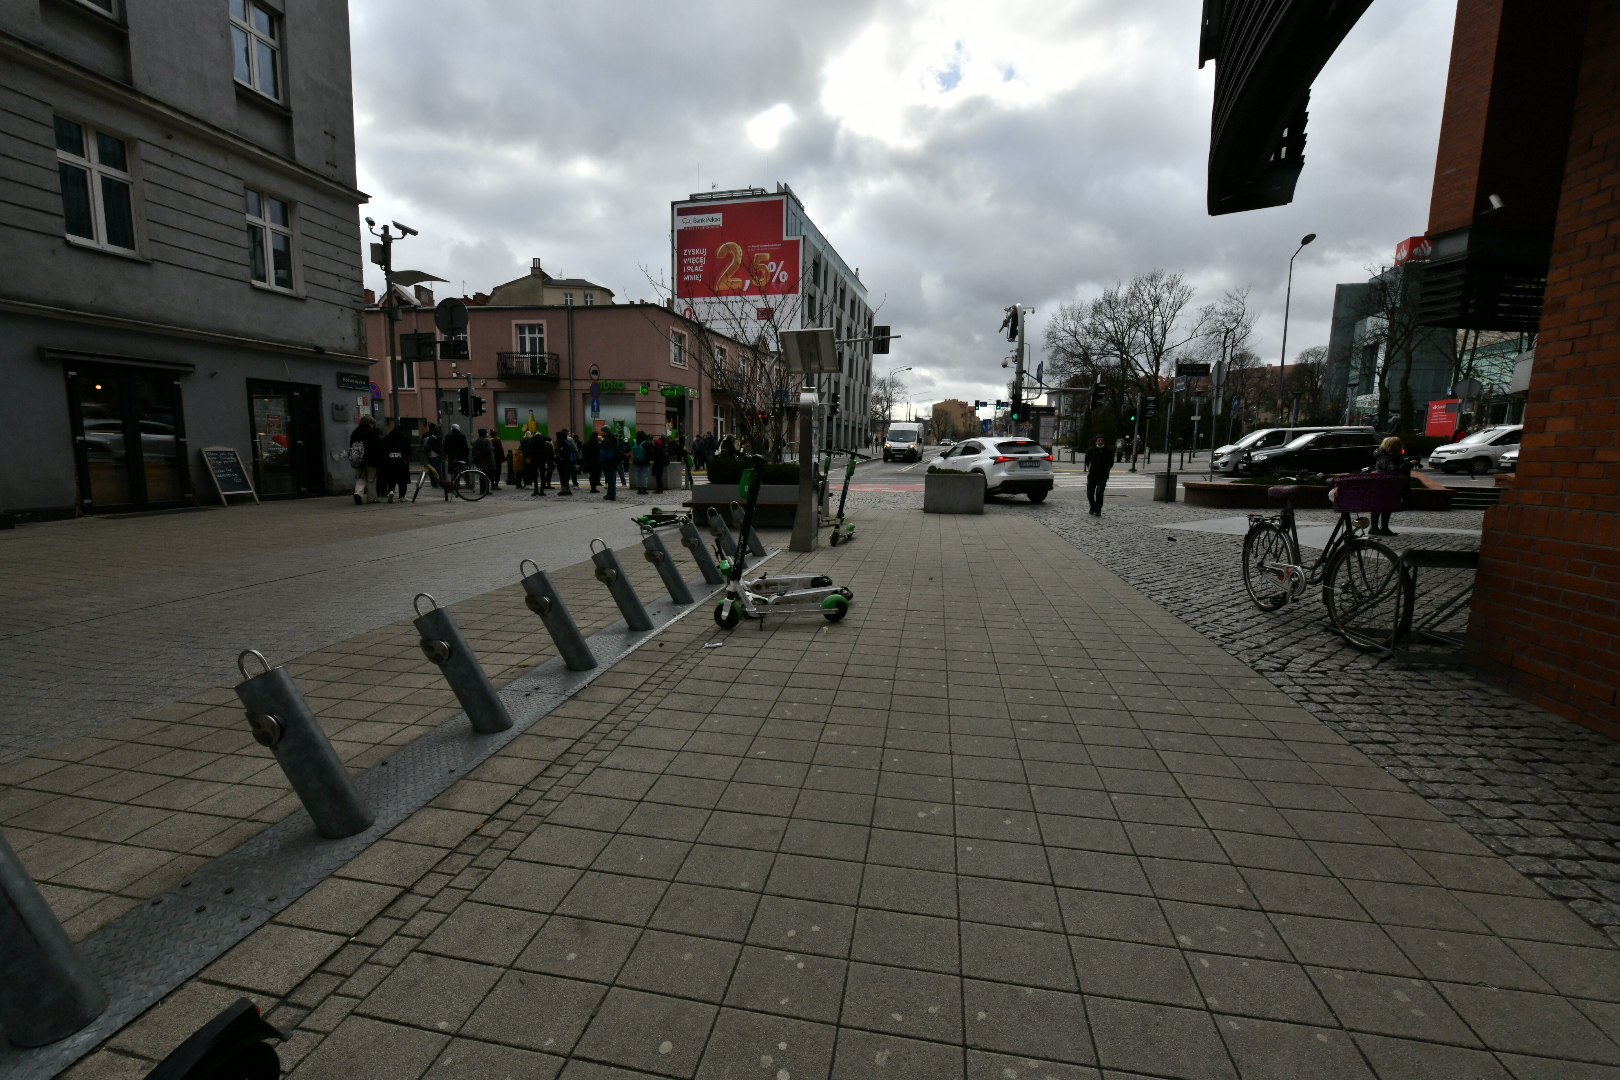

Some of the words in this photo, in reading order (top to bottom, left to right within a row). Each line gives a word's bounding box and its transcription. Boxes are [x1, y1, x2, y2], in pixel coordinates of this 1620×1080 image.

[683, 248, 707, 256] ZYSKUJ
[683, 256, 706, 265] WIĘCEJ
[715, 242, 788, 291] 2,5%
